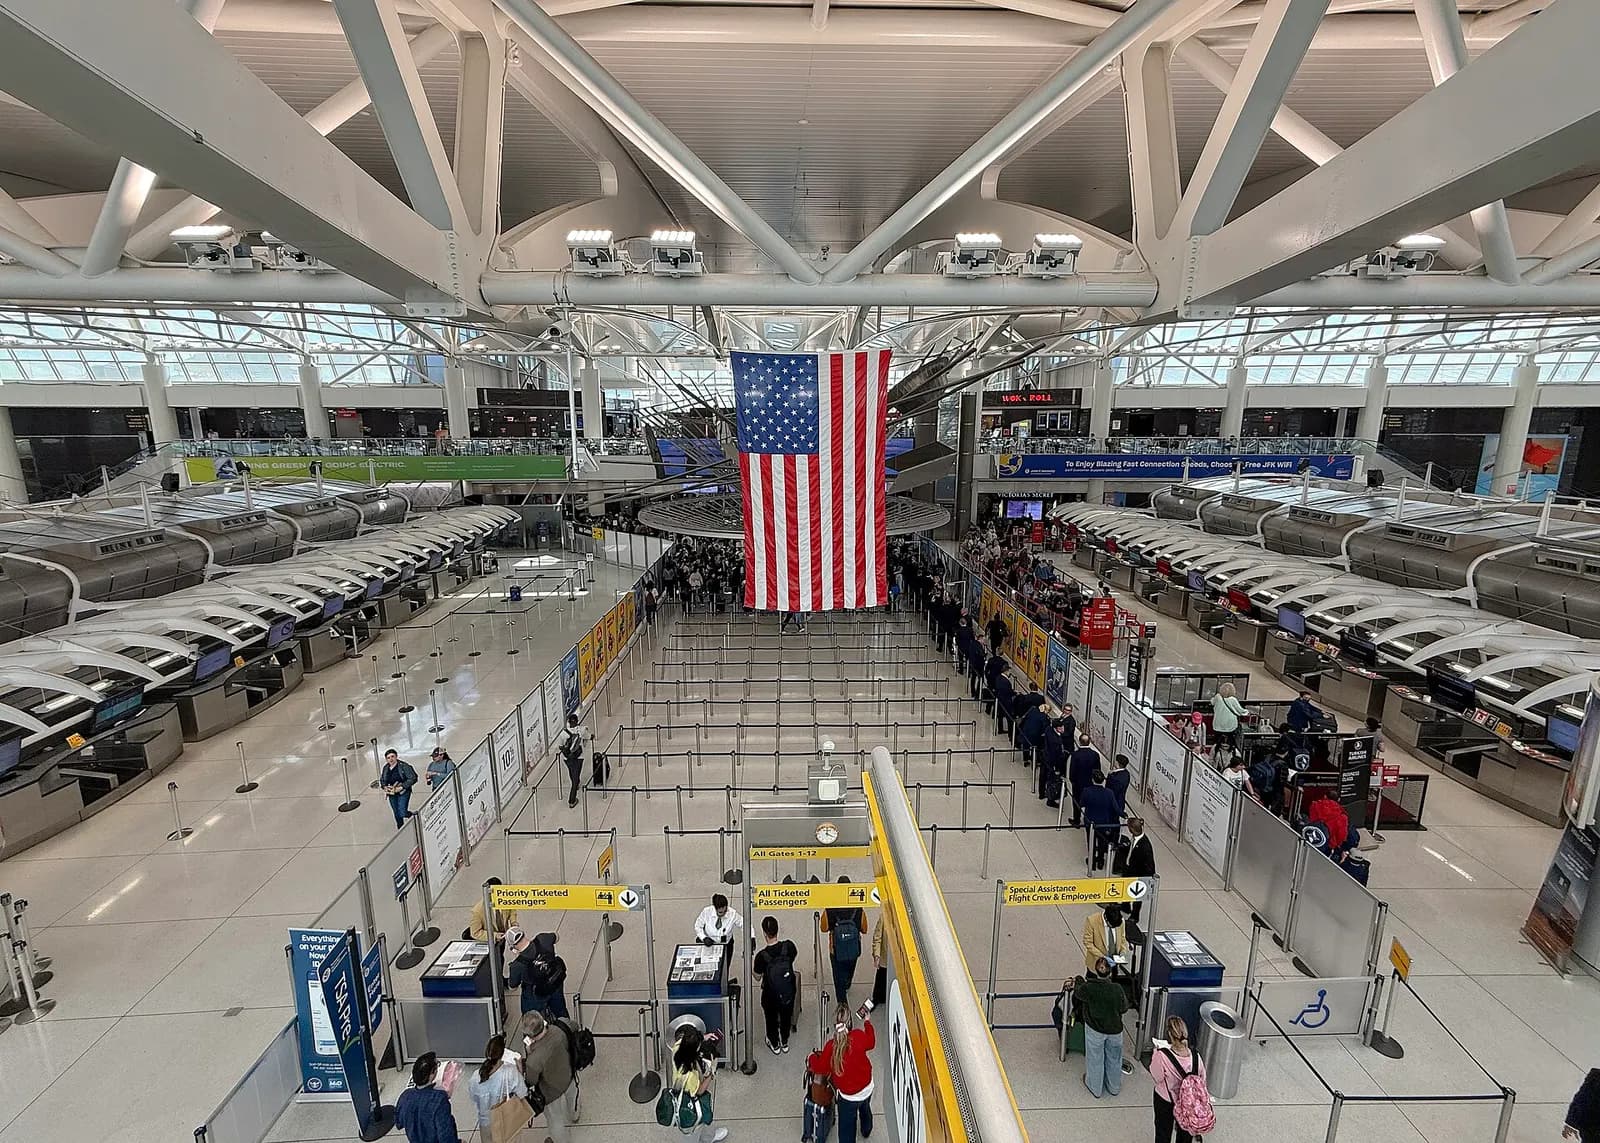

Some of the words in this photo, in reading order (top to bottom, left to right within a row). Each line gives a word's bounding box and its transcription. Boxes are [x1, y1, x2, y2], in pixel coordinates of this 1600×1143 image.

[1065, 460, 1074, 468] To
[1075, 460, 1095, 469] Enjoy
[1096, 460, 1122, 469] Blazing
[1122, 460, 1139, 468] Fast
[1139, 460, 1180, 468] Connection
[1161, 767, 1177, 785] BEAUTY
[496, 889, 531, 898] Priority
[532, 888, 569, 897] Ticketed
[758, 889, 771, 897] All
[772, 889, 810, 897] Ticketed
[1009, 885, 1036, 894] Special
[1038, 884, 1077, 893] Assistance
[1008, 894, 1030, 903] Flight
[1061, 892, 1102, 902] Employees
[497, 898, 546, 907] Passengers
[758, 898, 808, 907] Passengers
[309, 951, 326, 959] Now
[334, 971, 349, 1012] TSA
